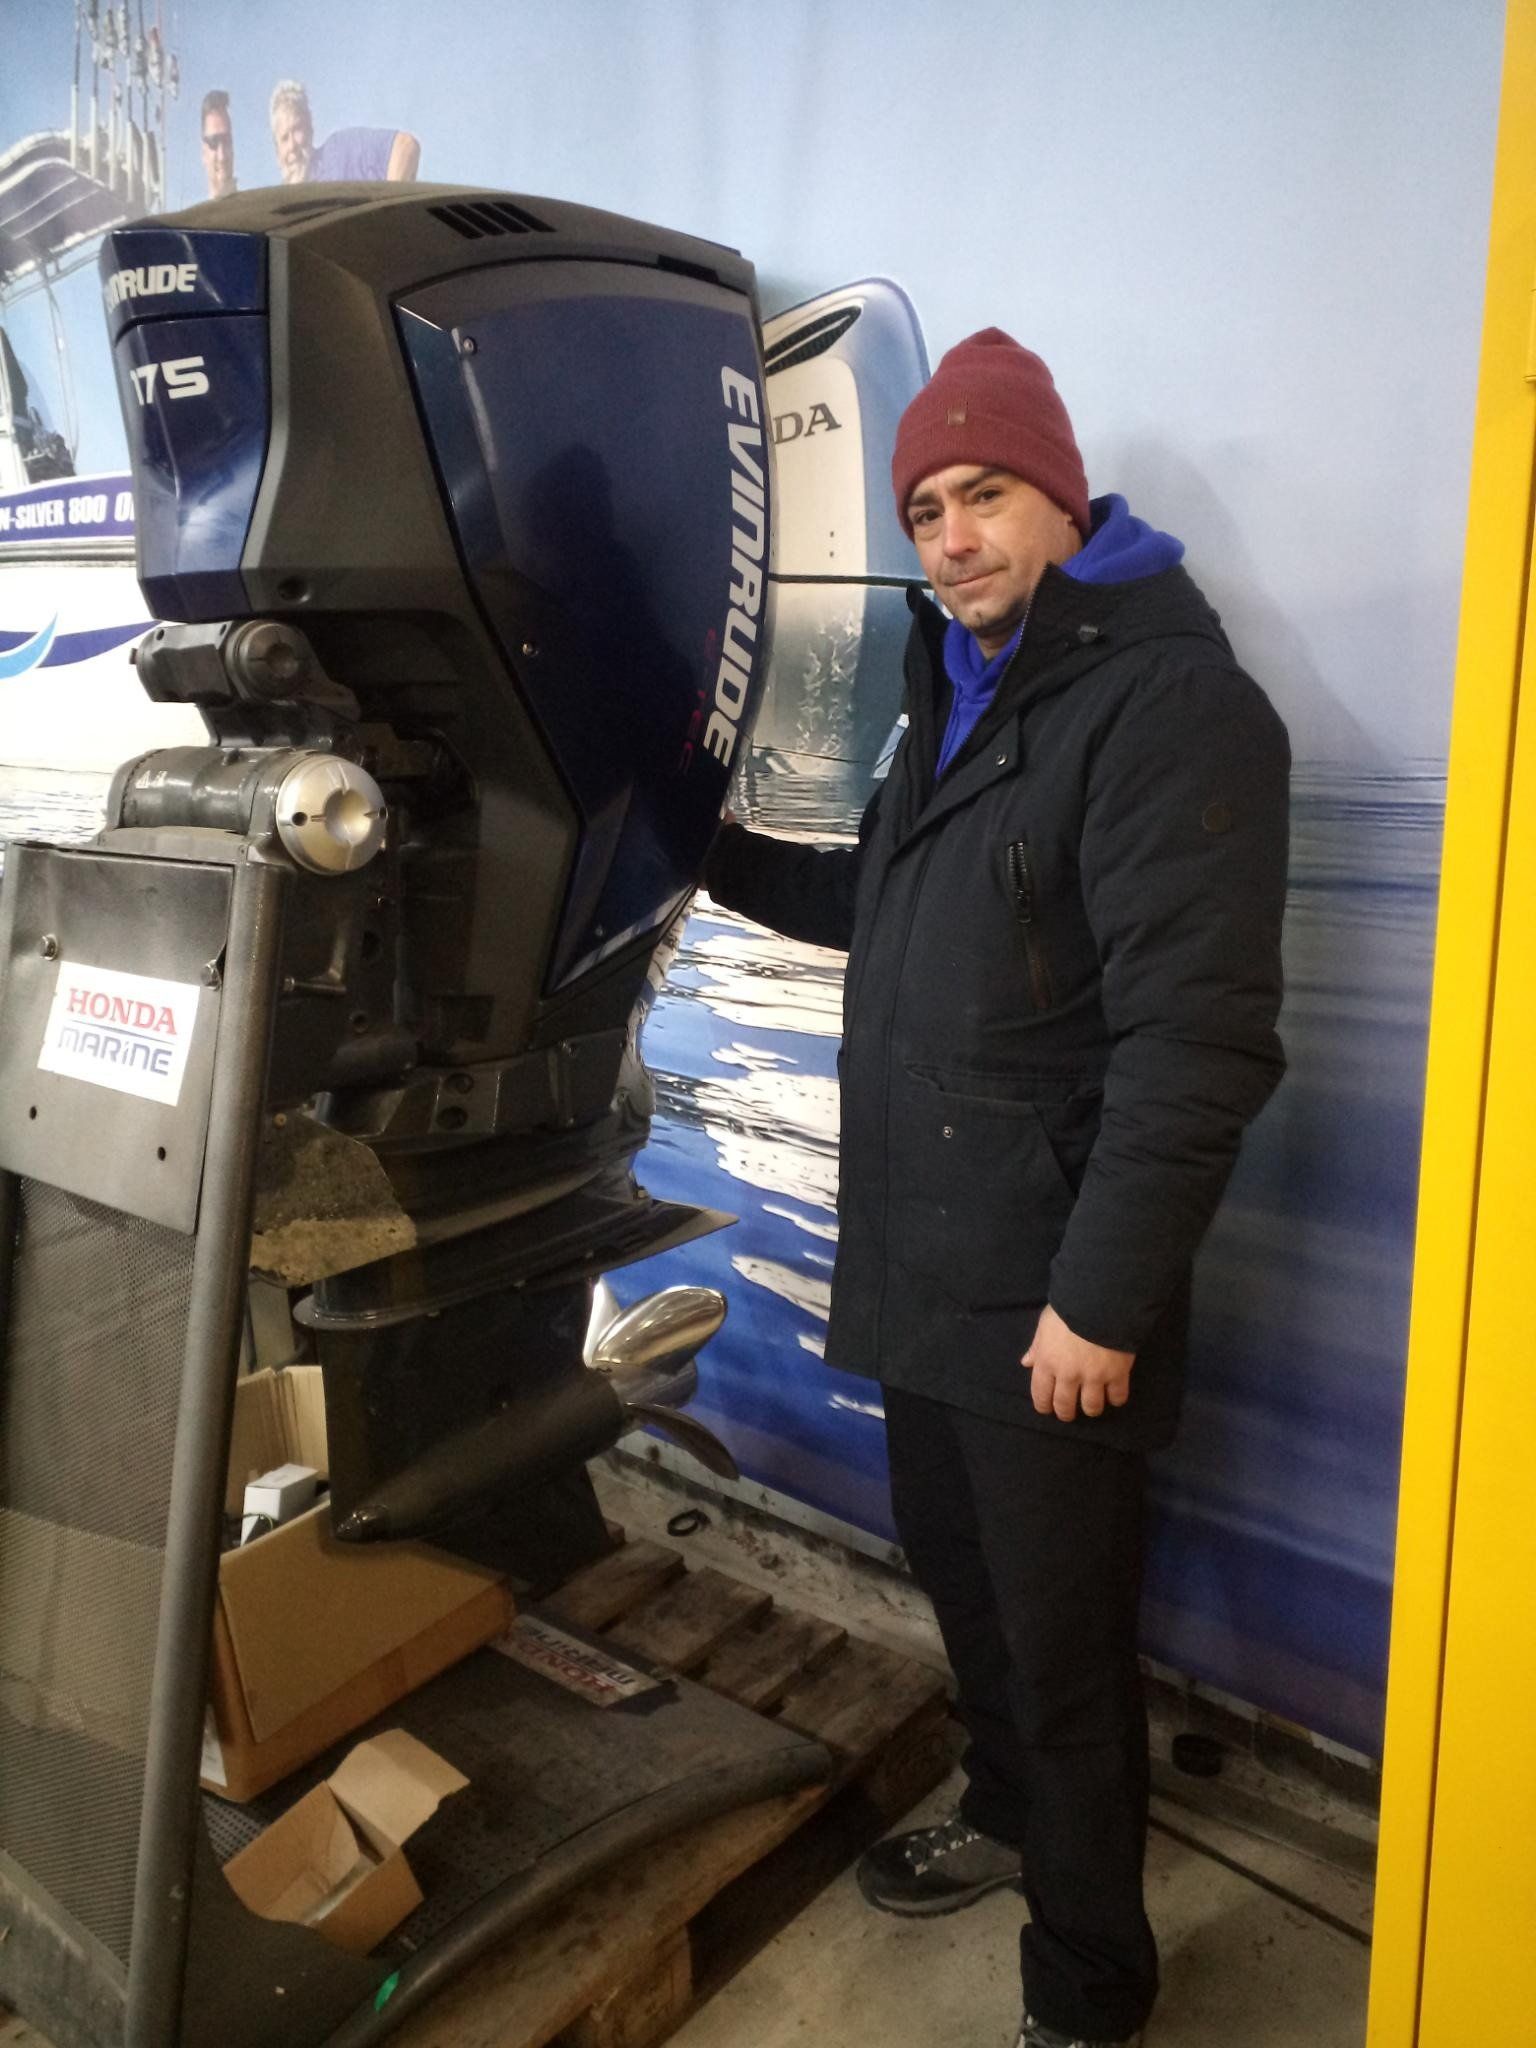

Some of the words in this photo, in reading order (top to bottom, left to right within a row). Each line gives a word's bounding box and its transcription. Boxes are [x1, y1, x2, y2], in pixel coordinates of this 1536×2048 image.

[130, 355, 209, 406] 175
[68, 494, 108, 524] 800
[114, 491, 135, 522] O
[703, 365, 765, 767] EVINRUDE
[67, 987, 177, 1035] HONDA
